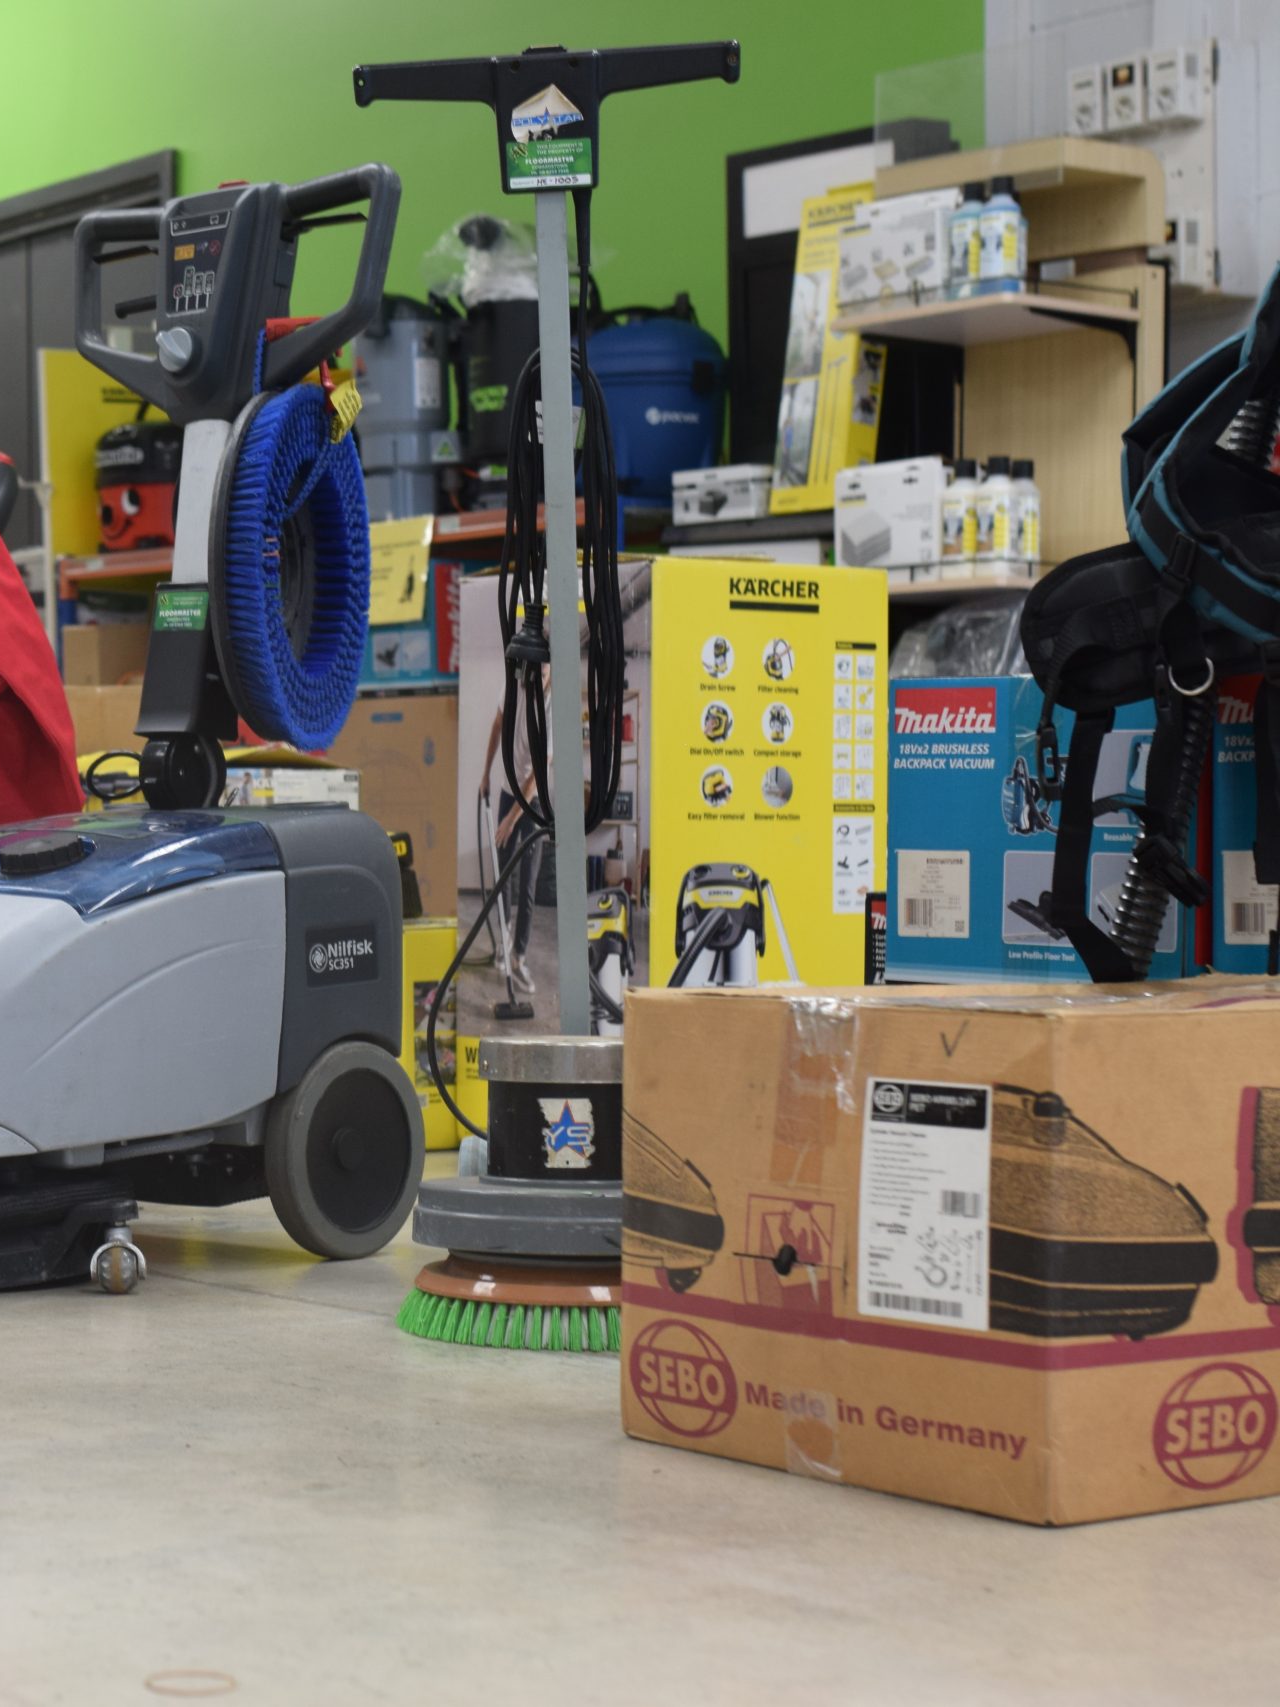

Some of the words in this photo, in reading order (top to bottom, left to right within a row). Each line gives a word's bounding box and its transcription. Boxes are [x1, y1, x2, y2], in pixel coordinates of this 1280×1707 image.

[525, 155, 574, 165] FLOORMASTER
[729, 577, 820, 599] KÄRCHER
[894, 706, 996, 734] makita
[899, 743, 929, 755] 18Vx2
[931, 743, 990, 755] BRUSHLESS
[893, 757, 946, 769] BACKPACK
[949, 757, 996, 769] VACUUM
[687, 813, 702, 821] Easy
[327, 939, 373, 959] Nilfisk
[328, 956, 354, 971] SC351
[639, 1350, 727, 1404] SEBO
[745, 1380, 827, 1419] Made
[838, 1398, 864, 1426] in
[874, 1405, 1028, 1461] Germany
[1164, 1399, 1267, 1455] SEBO
